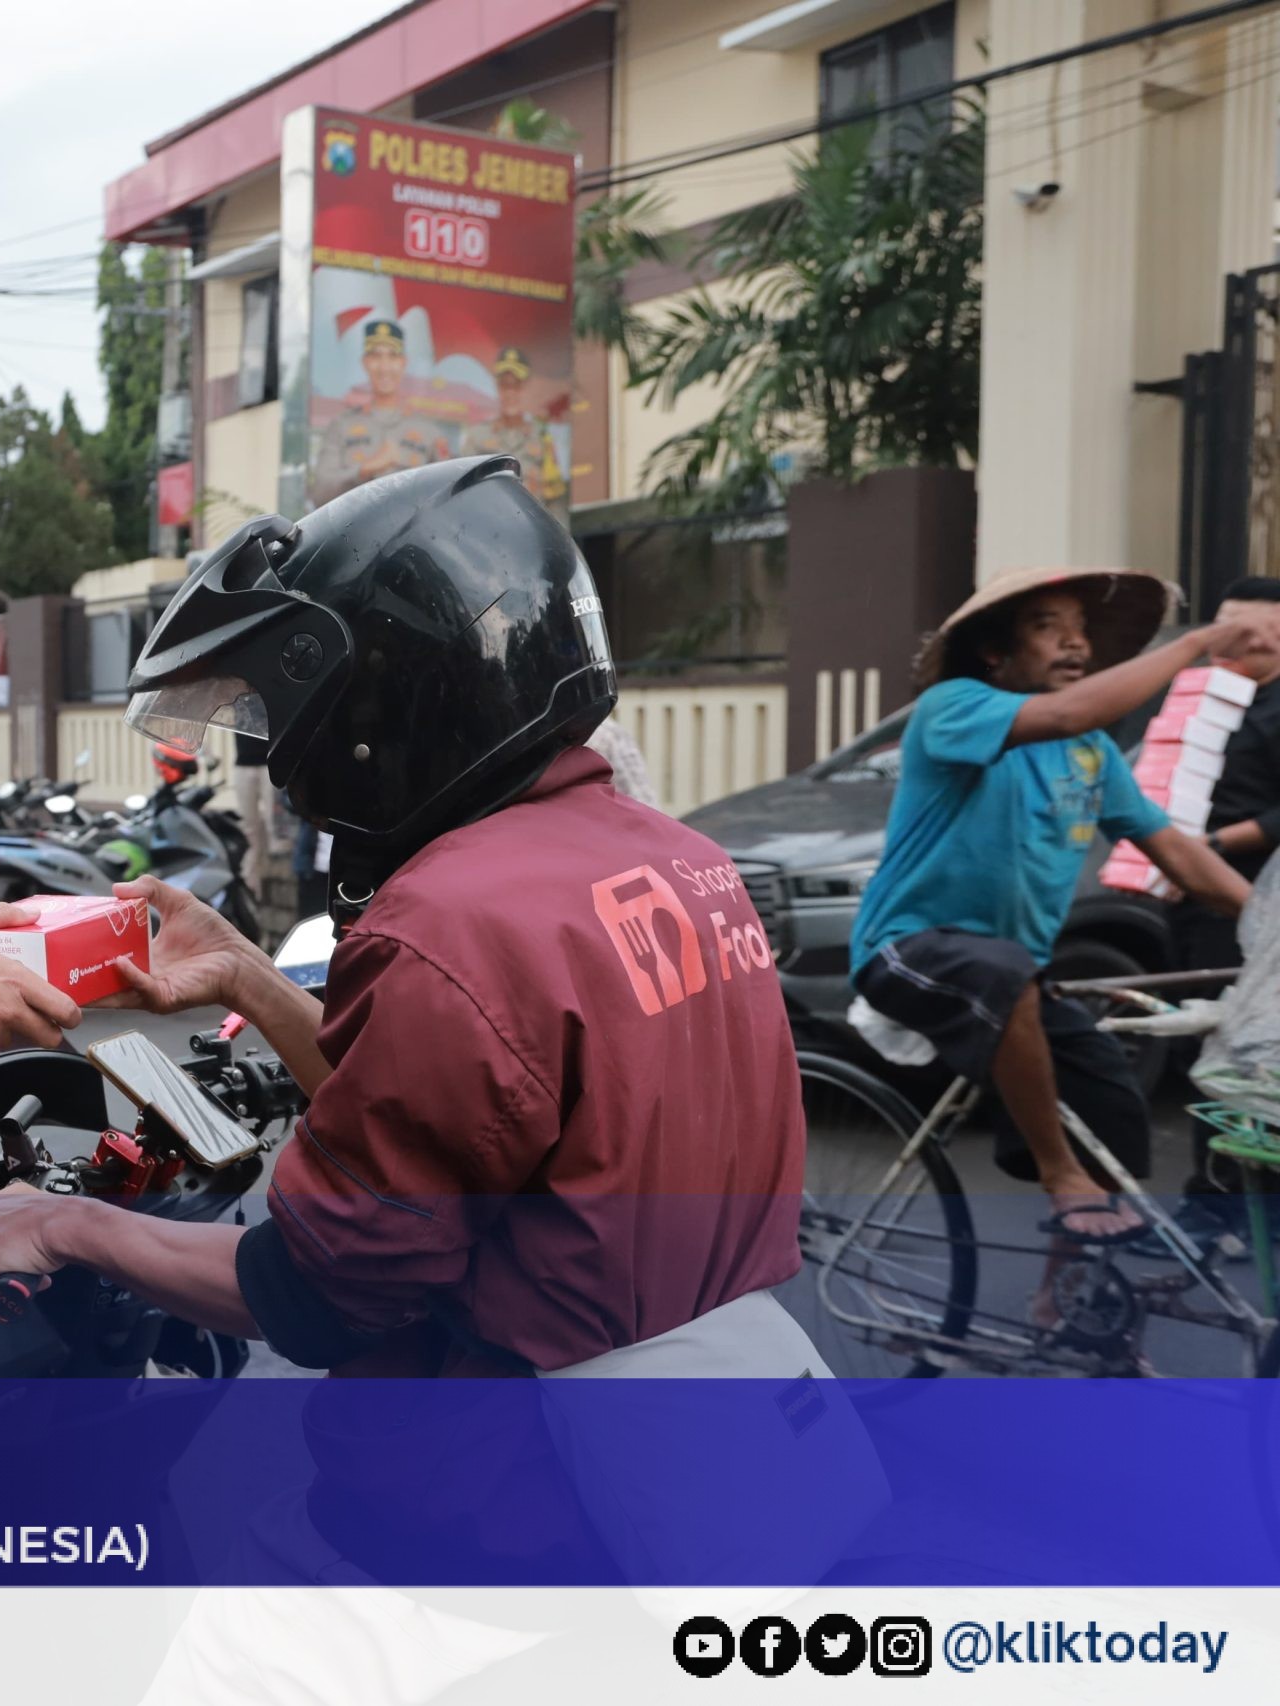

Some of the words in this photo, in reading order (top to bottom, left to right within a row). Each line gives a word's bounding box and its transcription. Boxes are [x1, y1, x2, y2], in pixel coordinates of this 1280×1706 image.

[370, 129, 468, 186] POLRES
[473, 151, 569, 206] JEMBER
[408, 217, 484, 258] 110
[709, 911, 770, 981] Foo
